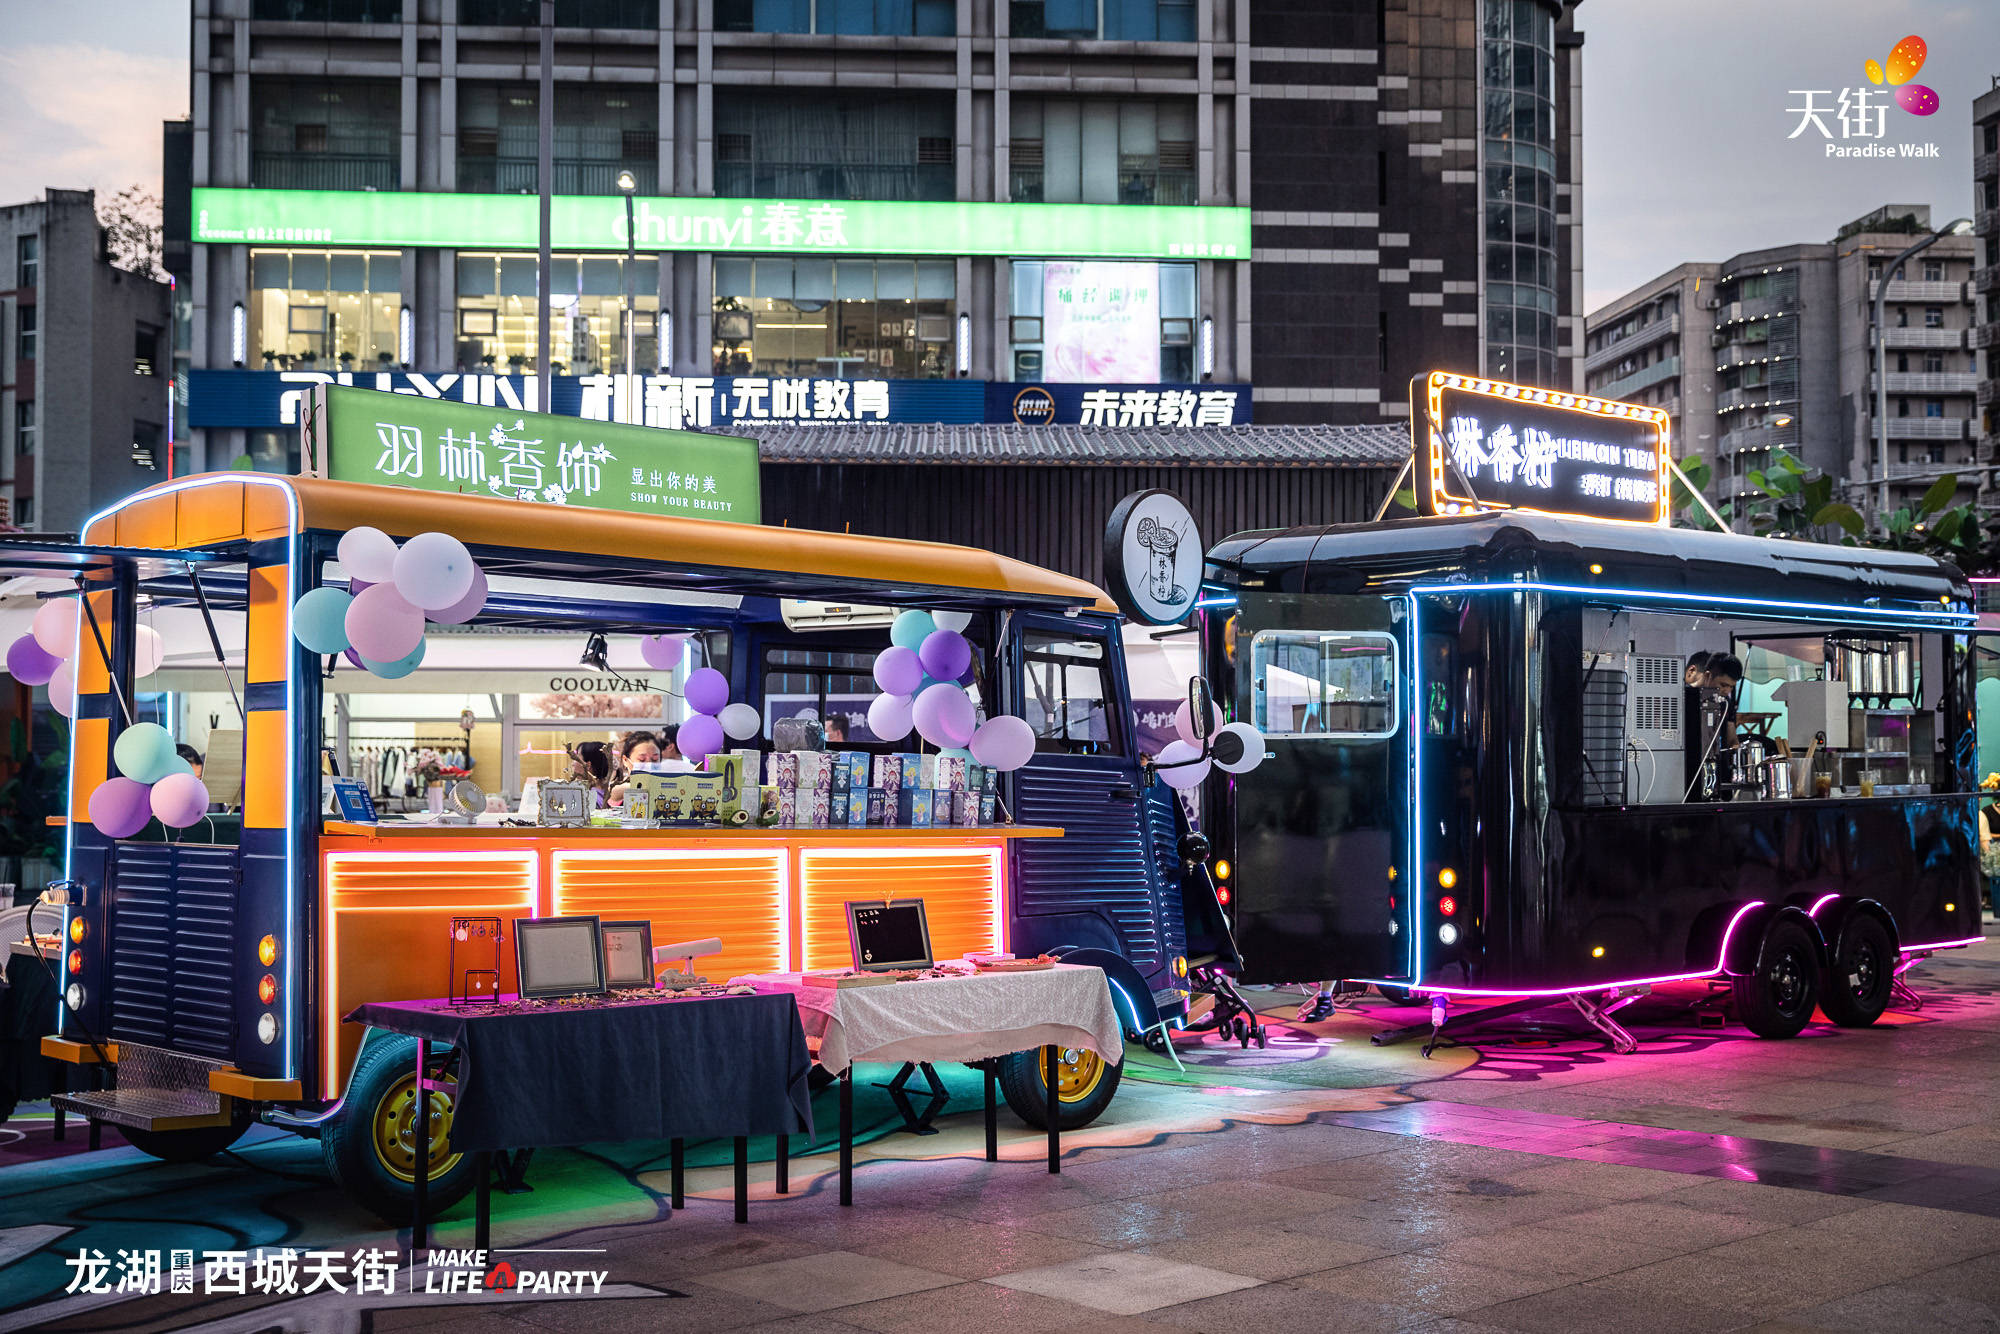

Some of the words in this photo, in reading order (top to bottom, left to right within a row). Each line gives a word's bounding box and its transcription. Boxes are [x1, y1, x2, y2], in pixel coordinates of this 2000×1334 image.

[611, 202, 752, 249] chunyi
[760, 202, 848, 246] 春意
[732, 377, 890, 419] 无忧教育
[1080, 389, 1238, 428] 未来教育
[375, 422, 603, 496] 羽林香饰
[631, 467, 718, 494] 显出你的美
[631, 491, 658, 504] SHOW
[663, 495, 689, 508] YOUR
[694, 499, 732, 512] BEAUTY
[550, 677, 649, 692] COOLVAN
